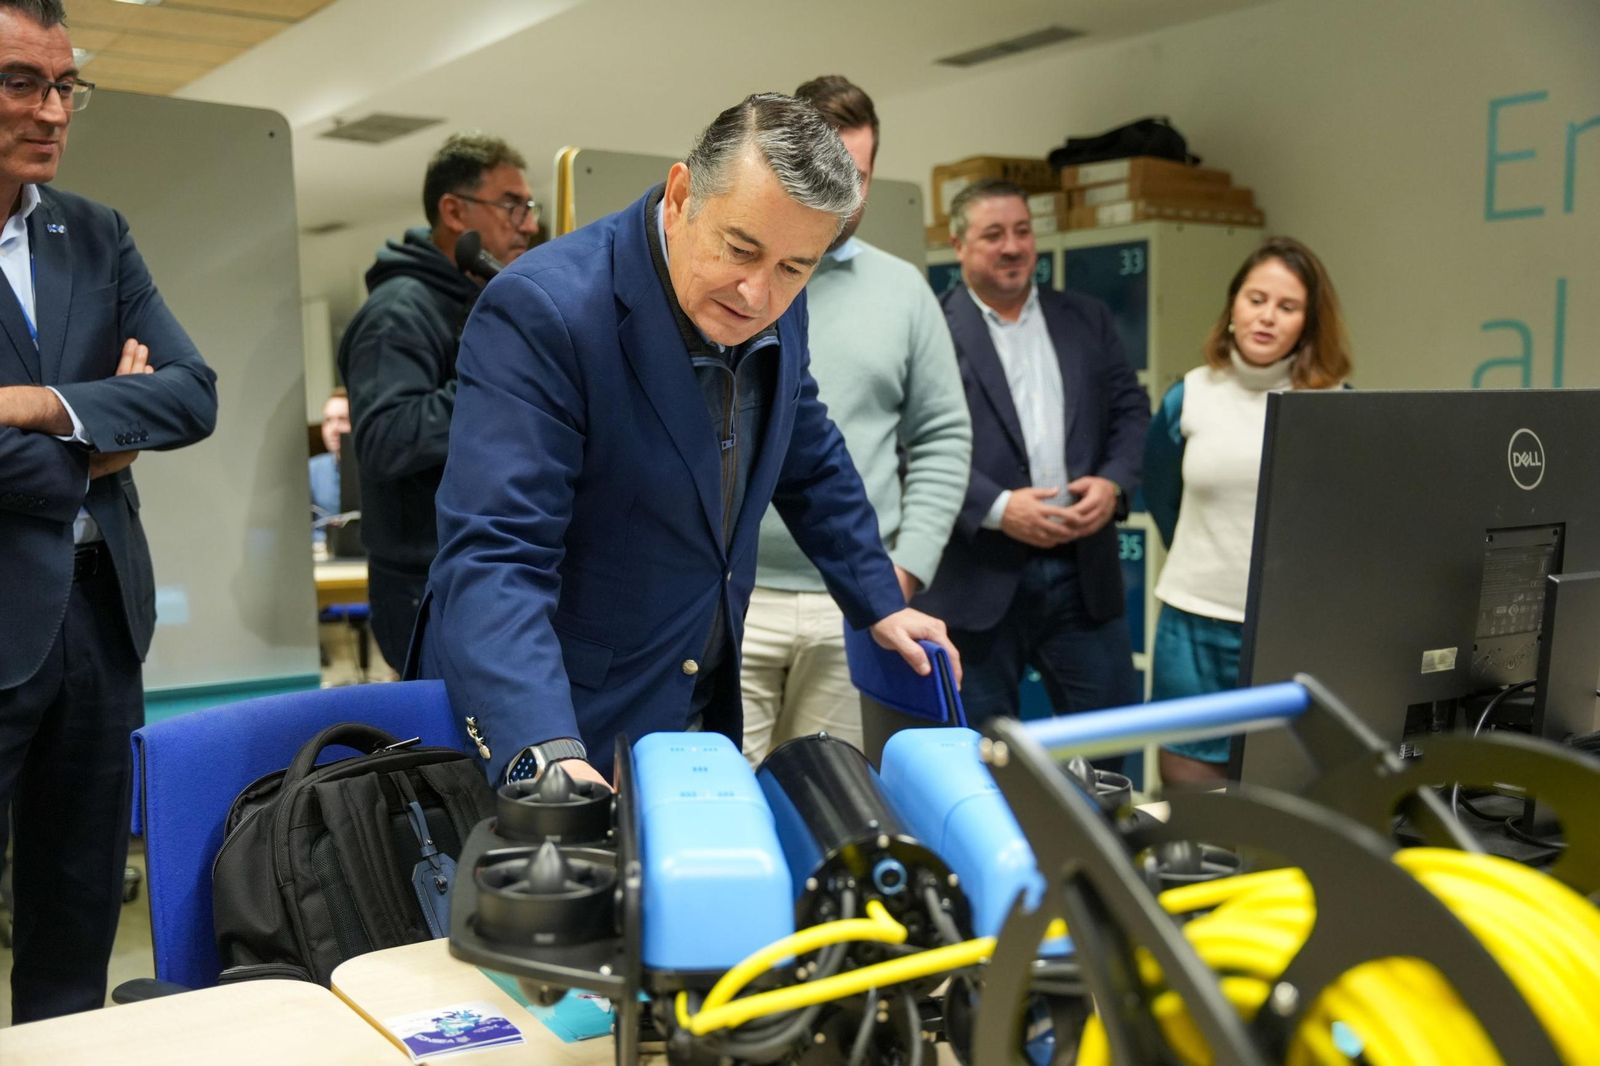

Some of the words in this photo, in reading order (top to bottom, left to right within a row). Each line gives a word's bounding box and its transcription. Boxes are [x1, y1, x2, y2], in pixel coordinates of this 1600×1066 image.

[1119, 248, 1144, 275] 33
[1512, 451, 1542, 467] DELL
[1118, 533, 1143, 560] 35
